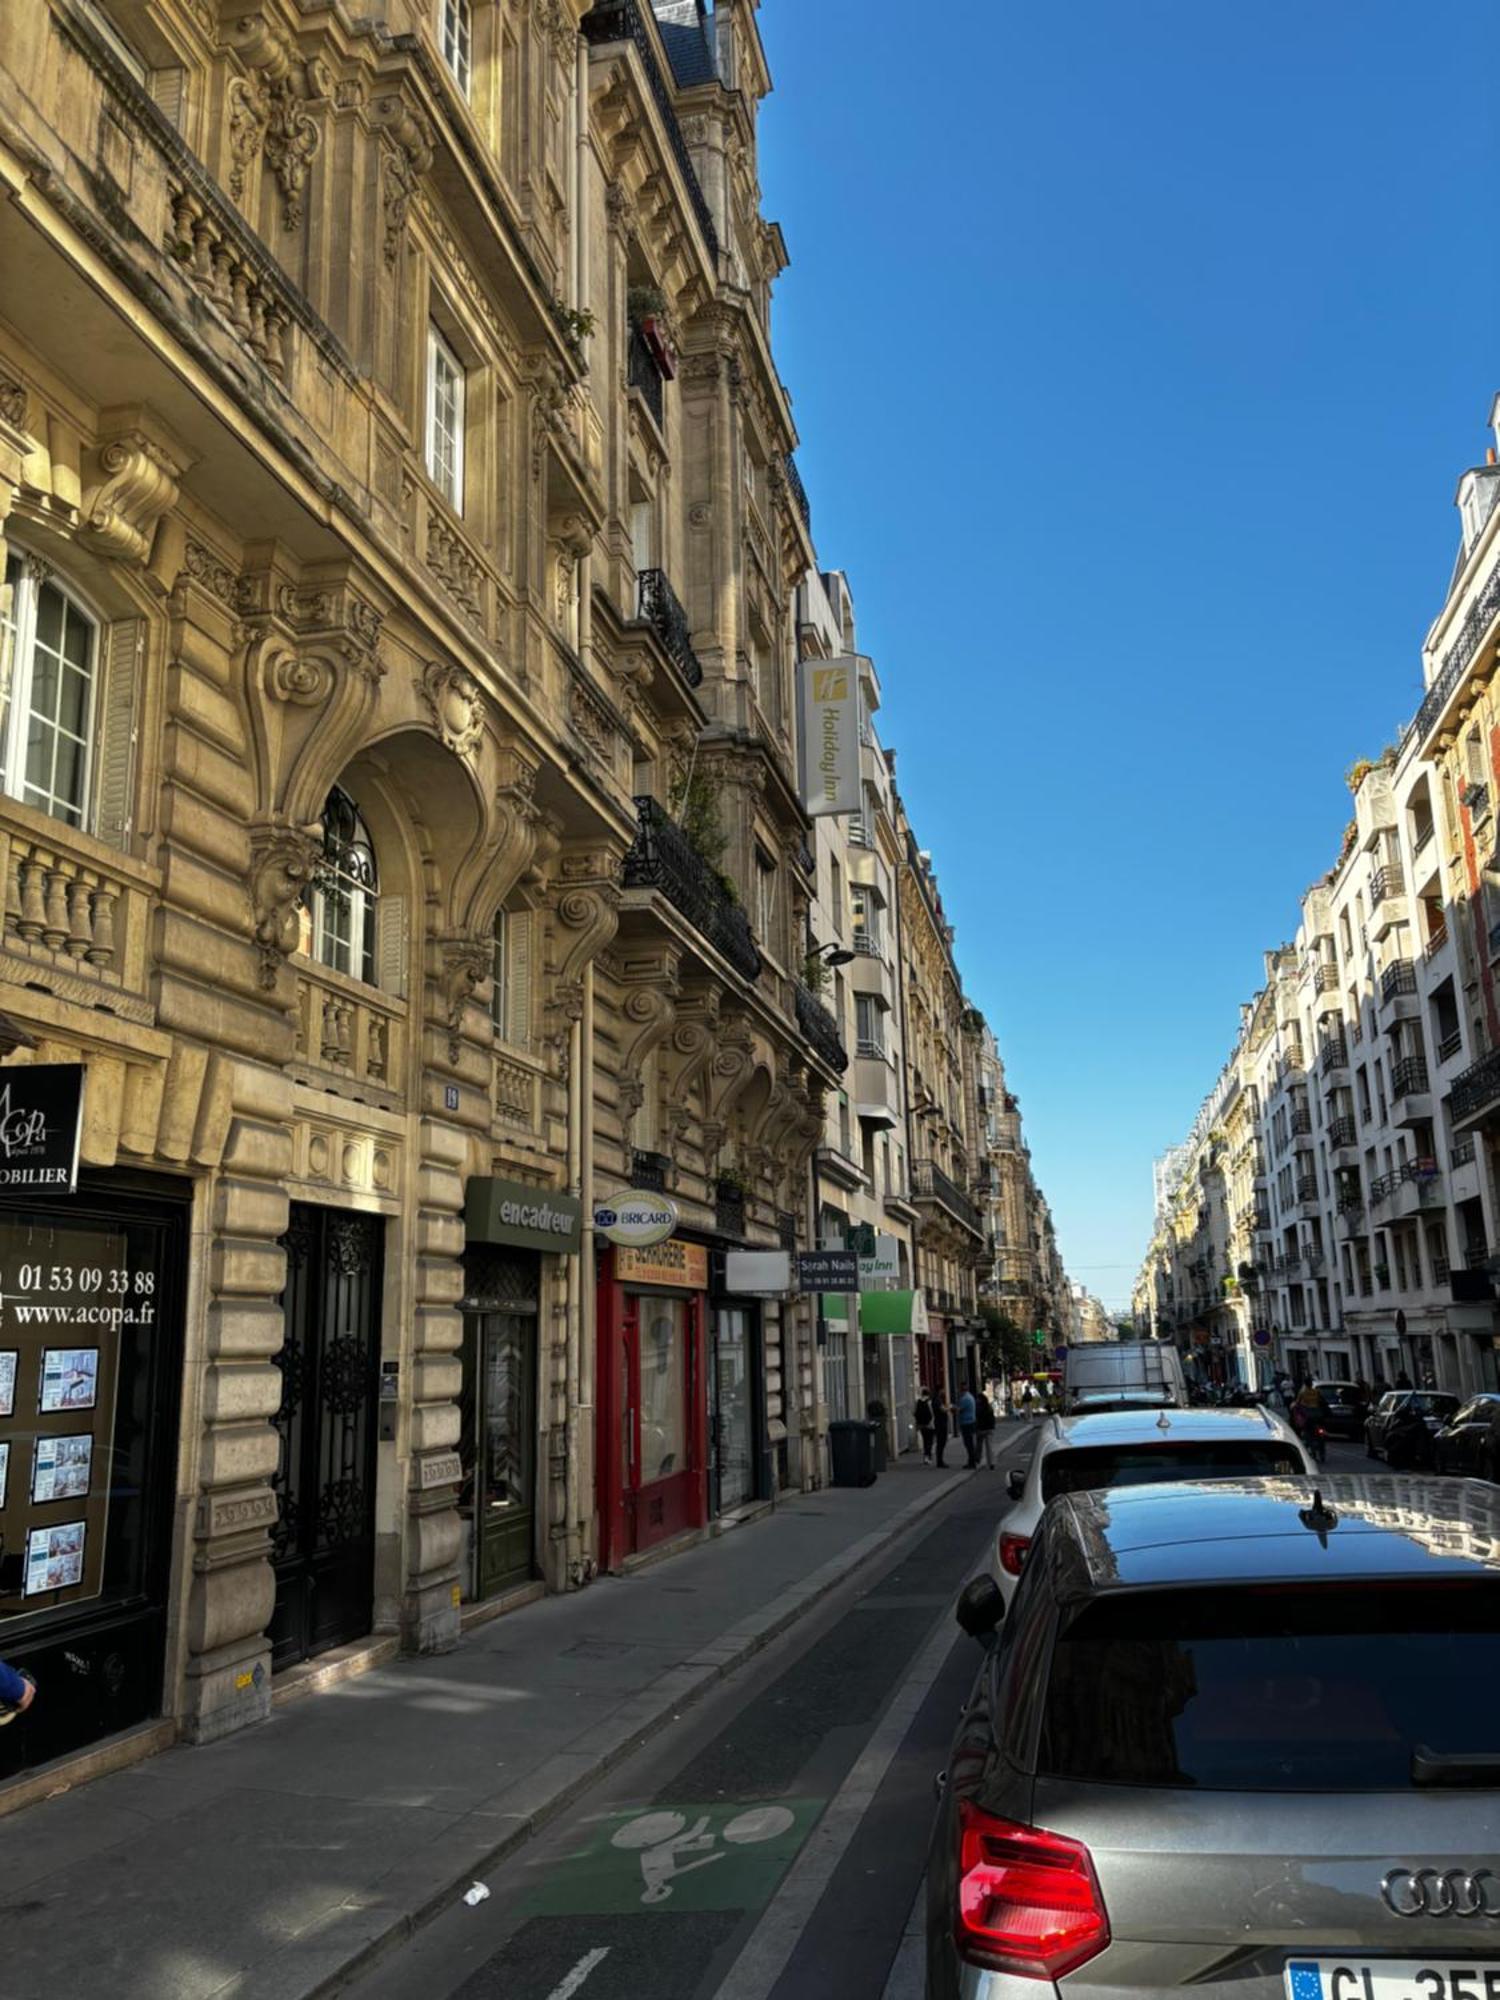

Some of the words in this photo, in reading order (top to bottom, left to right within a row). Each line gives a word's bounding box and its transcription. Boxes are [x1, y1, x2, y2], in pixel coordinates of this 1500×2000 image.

[819, 707, 841, 772] Holiday
[824, 775, 841, 801] Inn
[500, 1201, 575, 1234] encadreur
[621, 1211, 672, 1225] BRICARD
[19, 1264, 43, 1291] 01
[49, 1266, 74, 1292] 53
[79, 1267, 103, 1293] 09
[107, 1269, 129, 1294] 33
[134, 1271, 155, 1295] 88
[14, 1301, 155, 1331] www.acopa.fr
